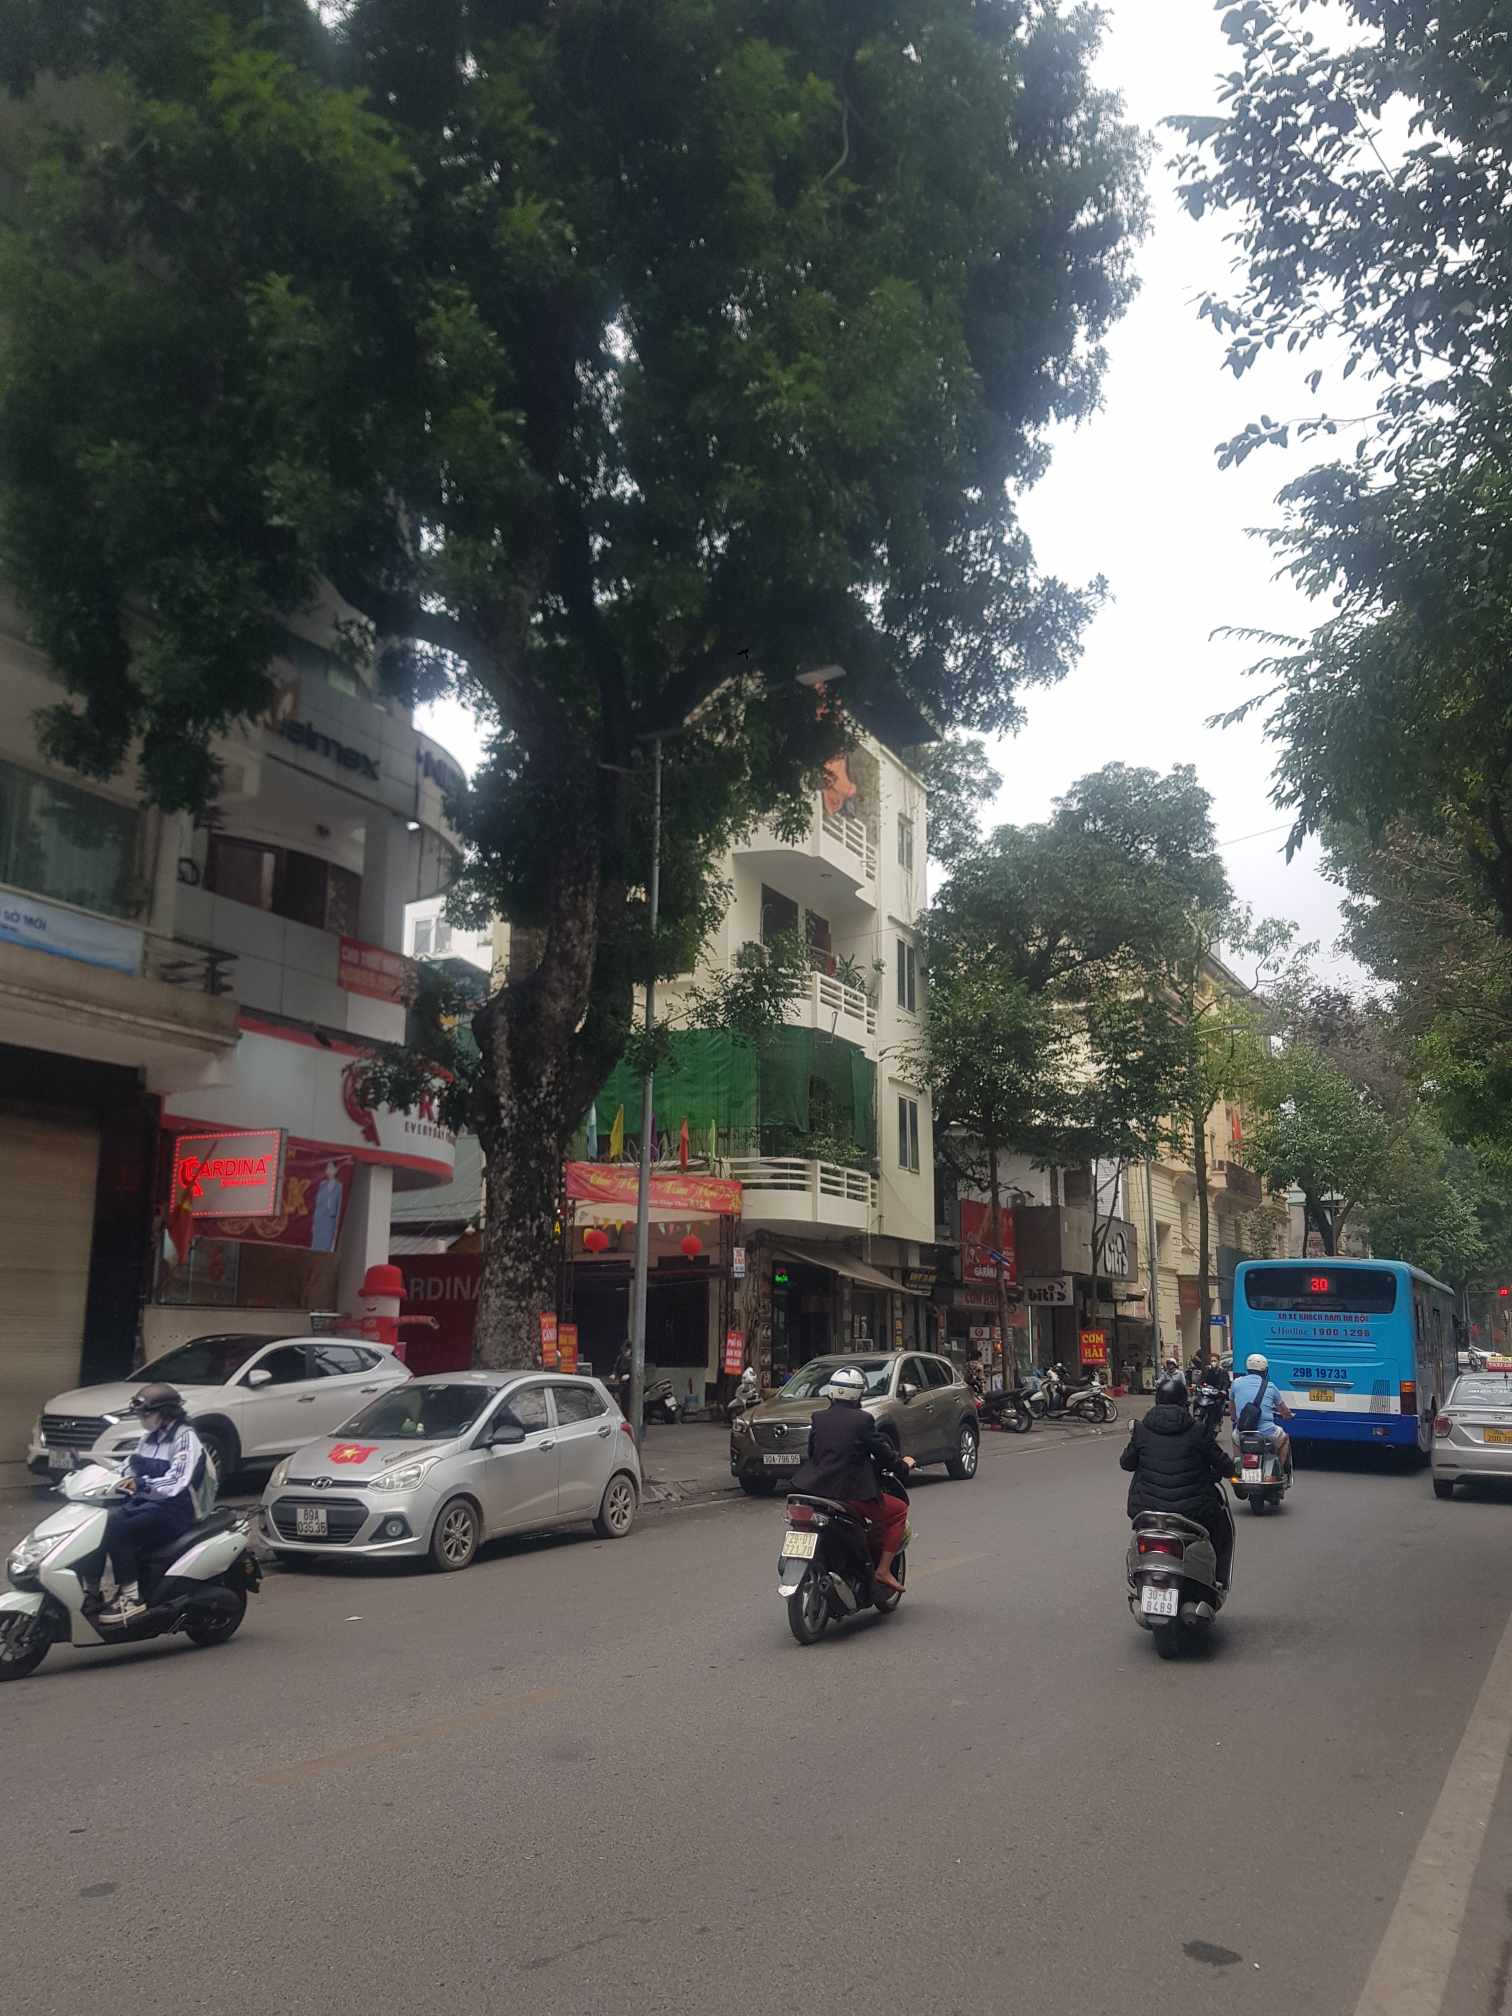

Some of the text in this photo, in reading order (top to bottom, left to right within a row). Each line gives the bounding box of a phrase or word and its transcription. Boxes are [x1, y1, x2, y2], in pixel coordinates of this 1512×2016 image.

[1311, 1277, 1329, 1293] 30
[1293, 1367, 1348, 1380] 29B 19733
[303, 1508, 320, 1522] 89A
